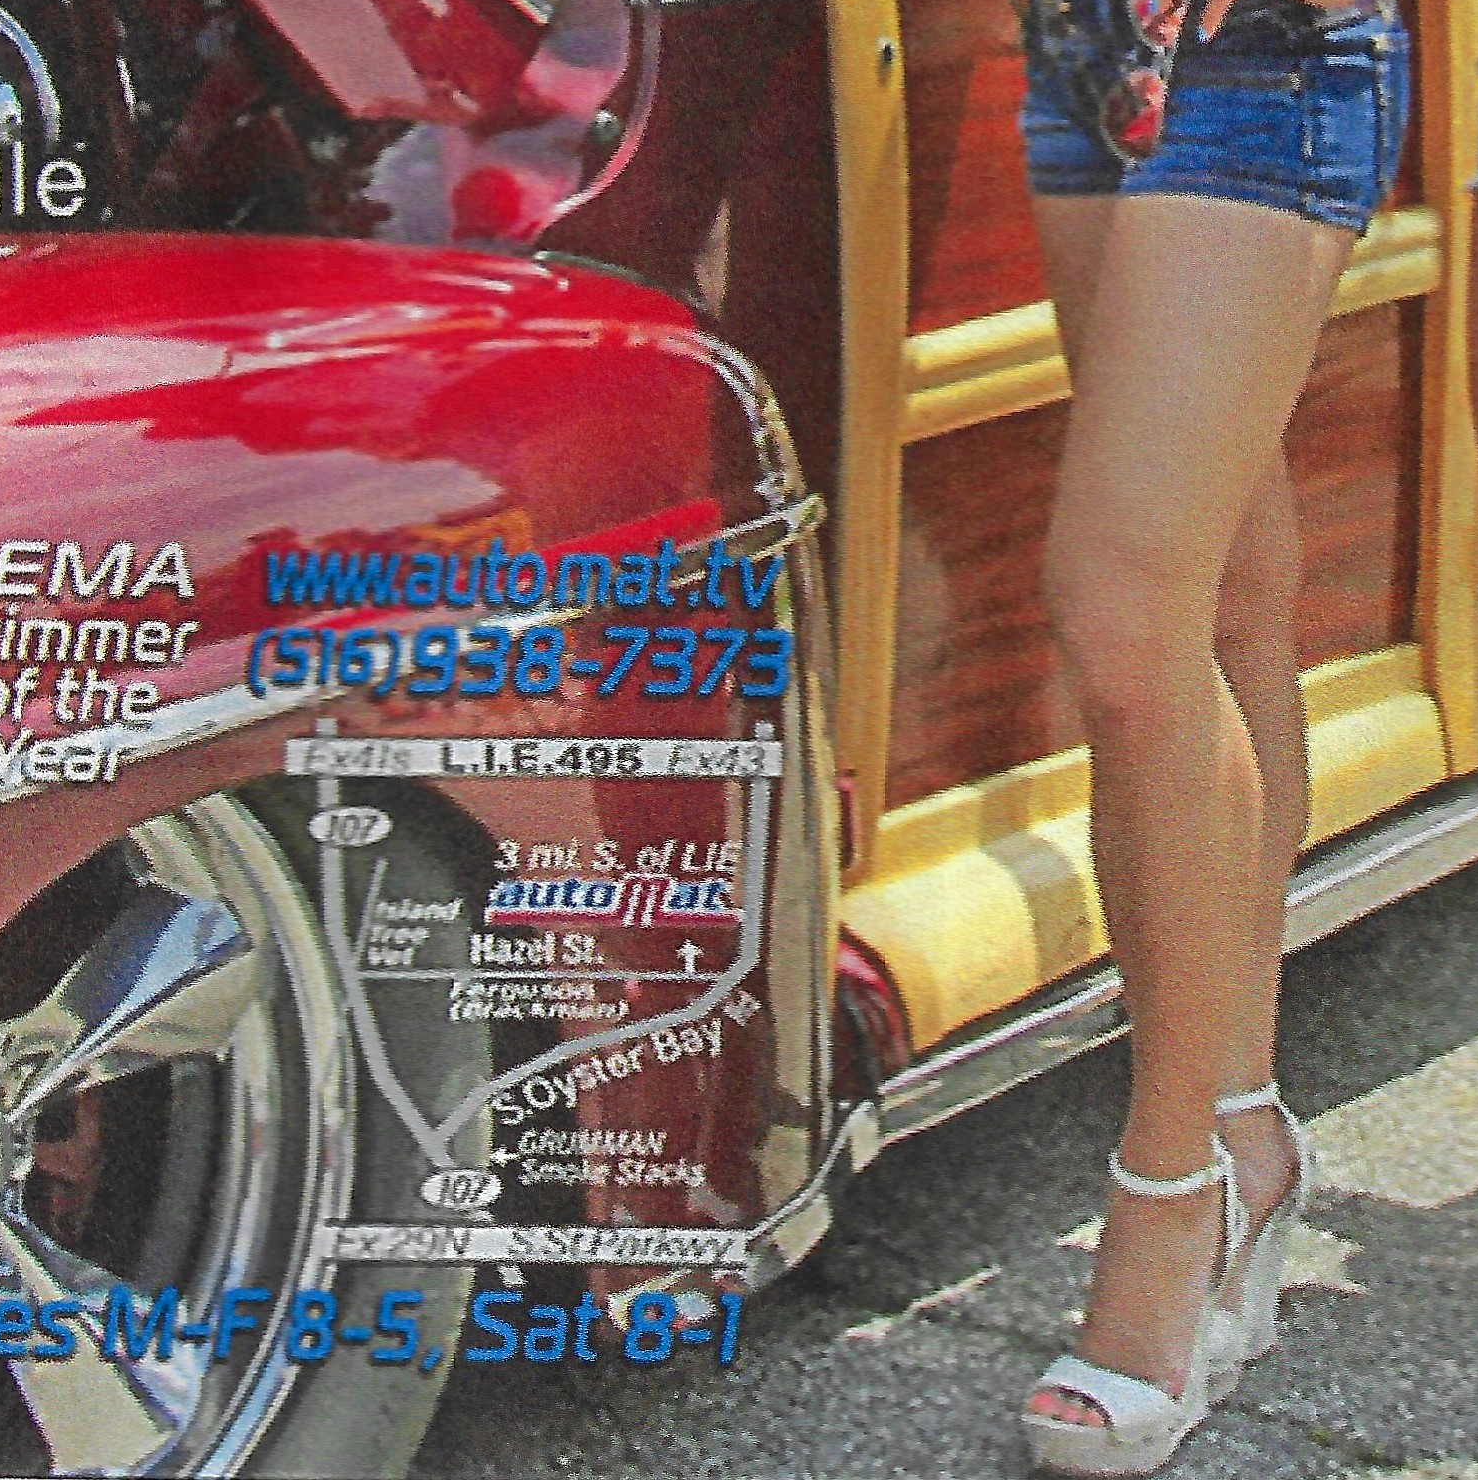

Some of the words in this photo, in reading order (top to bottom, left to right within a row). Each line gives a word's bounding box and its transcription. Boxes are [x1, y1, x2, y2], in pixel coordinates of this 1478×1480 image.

[266, 538, 784, 609] www.automat.tv
[247, 626, 793, 699] (516)938-7373
[54, 667, 160, 722] the
[330, 813, 379, 841] 107
[494, 838, 522, 871] 3
[636, 837, 678, 872] of
[681, 839, 744, 873] LIE
[470, 930, 556, 966] Hazel
[650, 1017, 722, 1064] Bay
[440, 1175, 489, 1206] 107
[103, 1285, 271, 1363] M-F
[287, 1288, 442, 1372] 8-5,
[465, 1290, 602, 1363] Sat
[625, 1291, 742, 1364] 8-1
